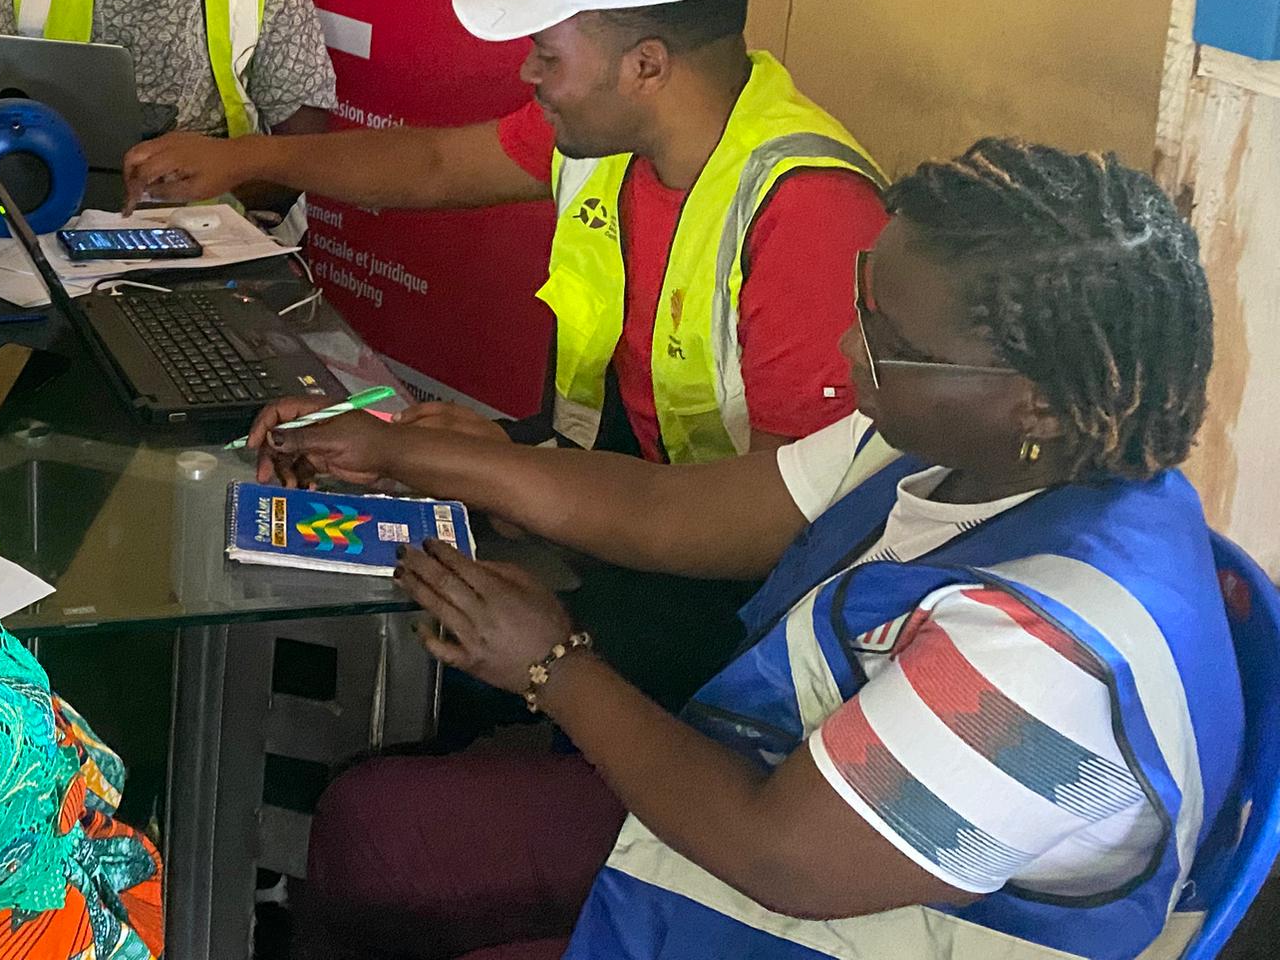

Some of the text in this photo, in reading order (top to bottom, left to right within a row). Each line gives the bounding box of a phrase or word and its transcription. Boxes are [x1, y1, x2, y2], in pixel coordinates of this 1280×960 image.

[314, 232, 428, 295] sociale et juridique
[316, 262, 327, 279] et
[330, 262, 383, 308] lobbying
